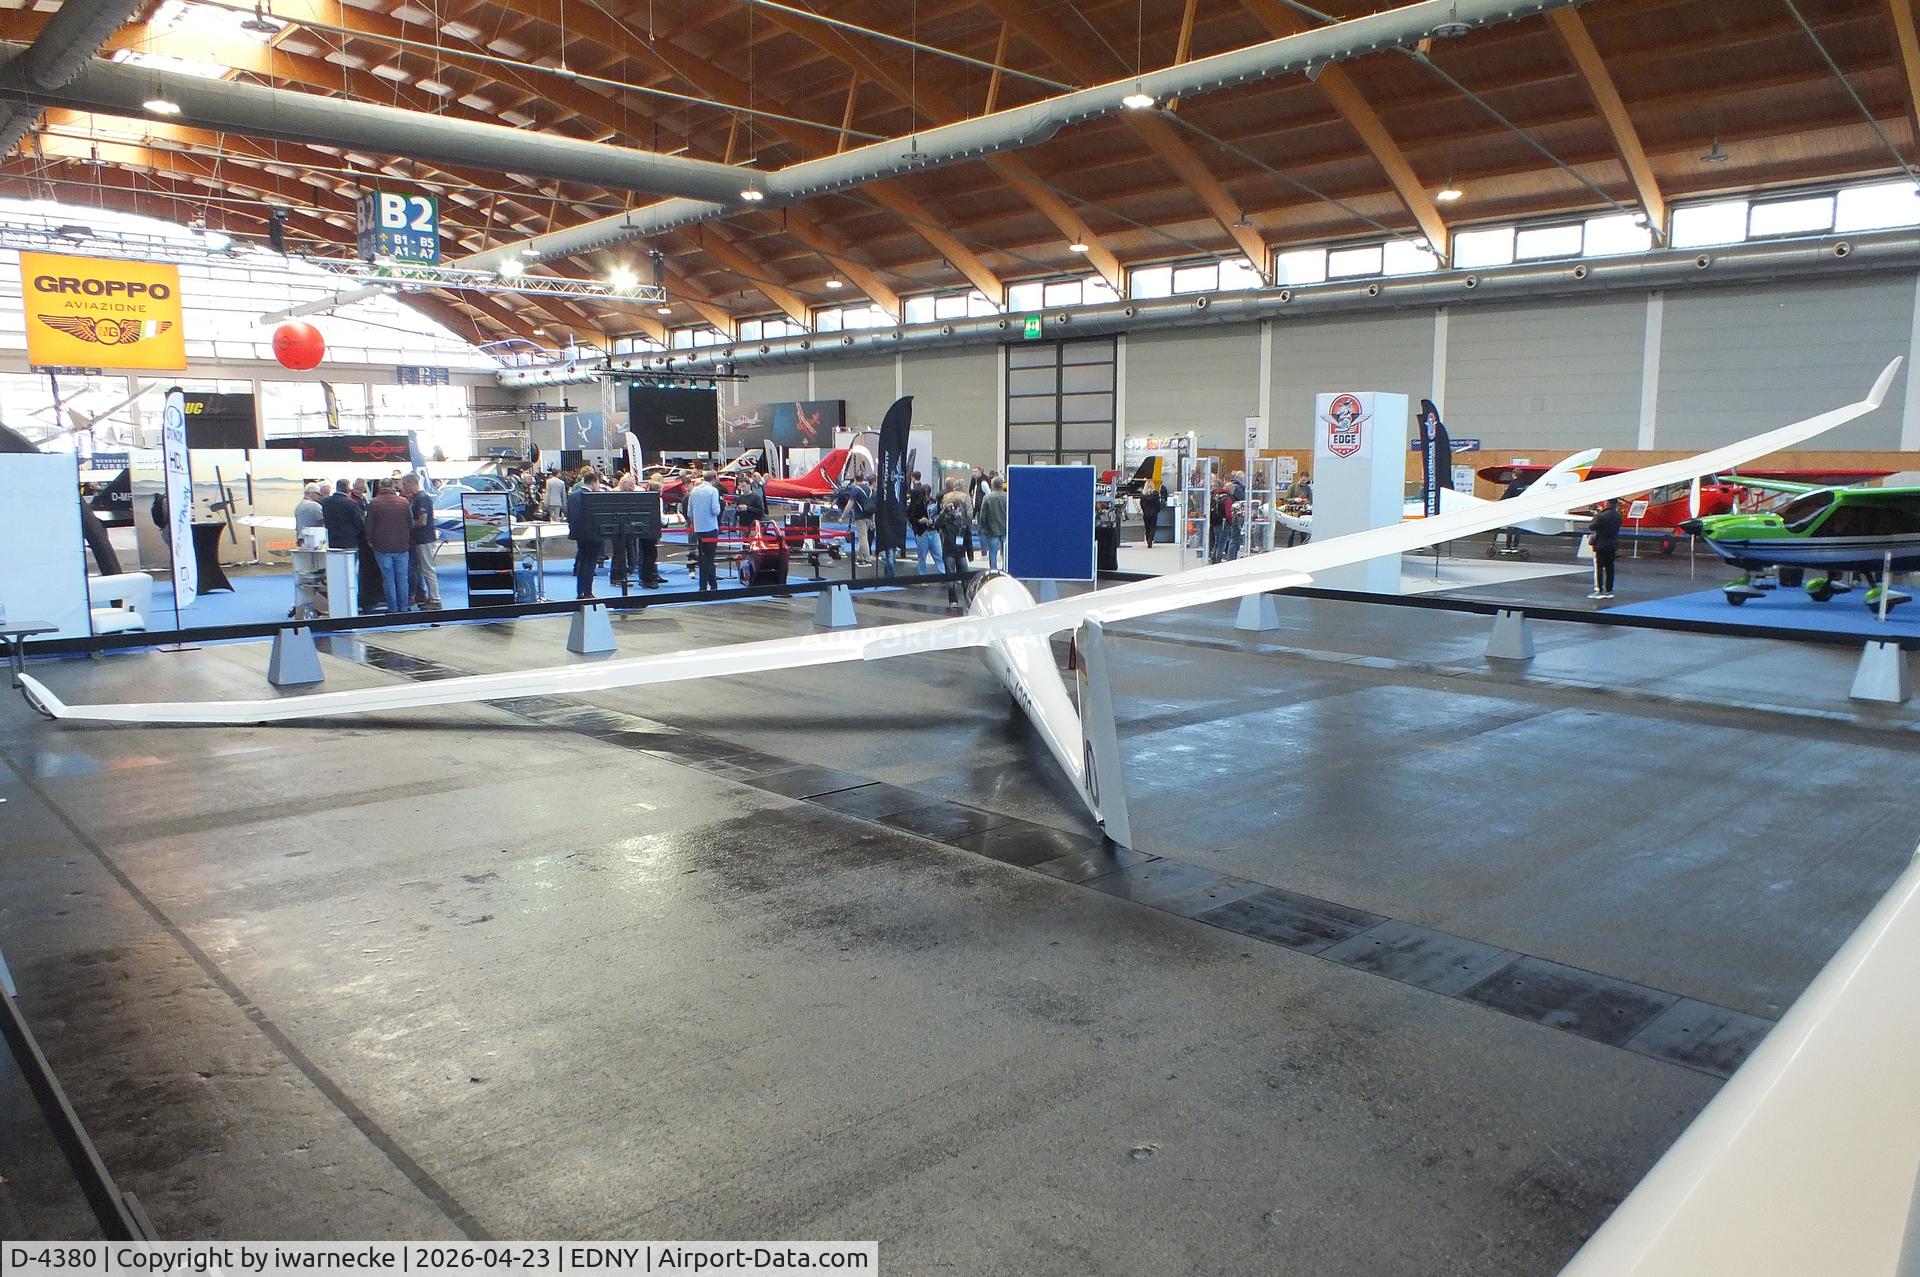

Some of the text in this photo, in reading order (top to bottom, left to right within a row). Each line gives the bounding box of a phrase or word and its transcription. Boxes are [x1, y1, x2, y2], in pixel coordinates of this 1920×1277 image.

[381, 192, 433, 232] B2
[393, 234, 408, 246] B1
[420, 236, 435, 249] B5
[394, 245, 409, 257] A1
[420, 248, 435, 260] A7
[34, 275, 171, 300] GROPPO
[64, 300, 147, 313] AVIAZIONE
[1333, 434, 1356, 444] EDGE
[1427, 491, 1436, 517] DGE
